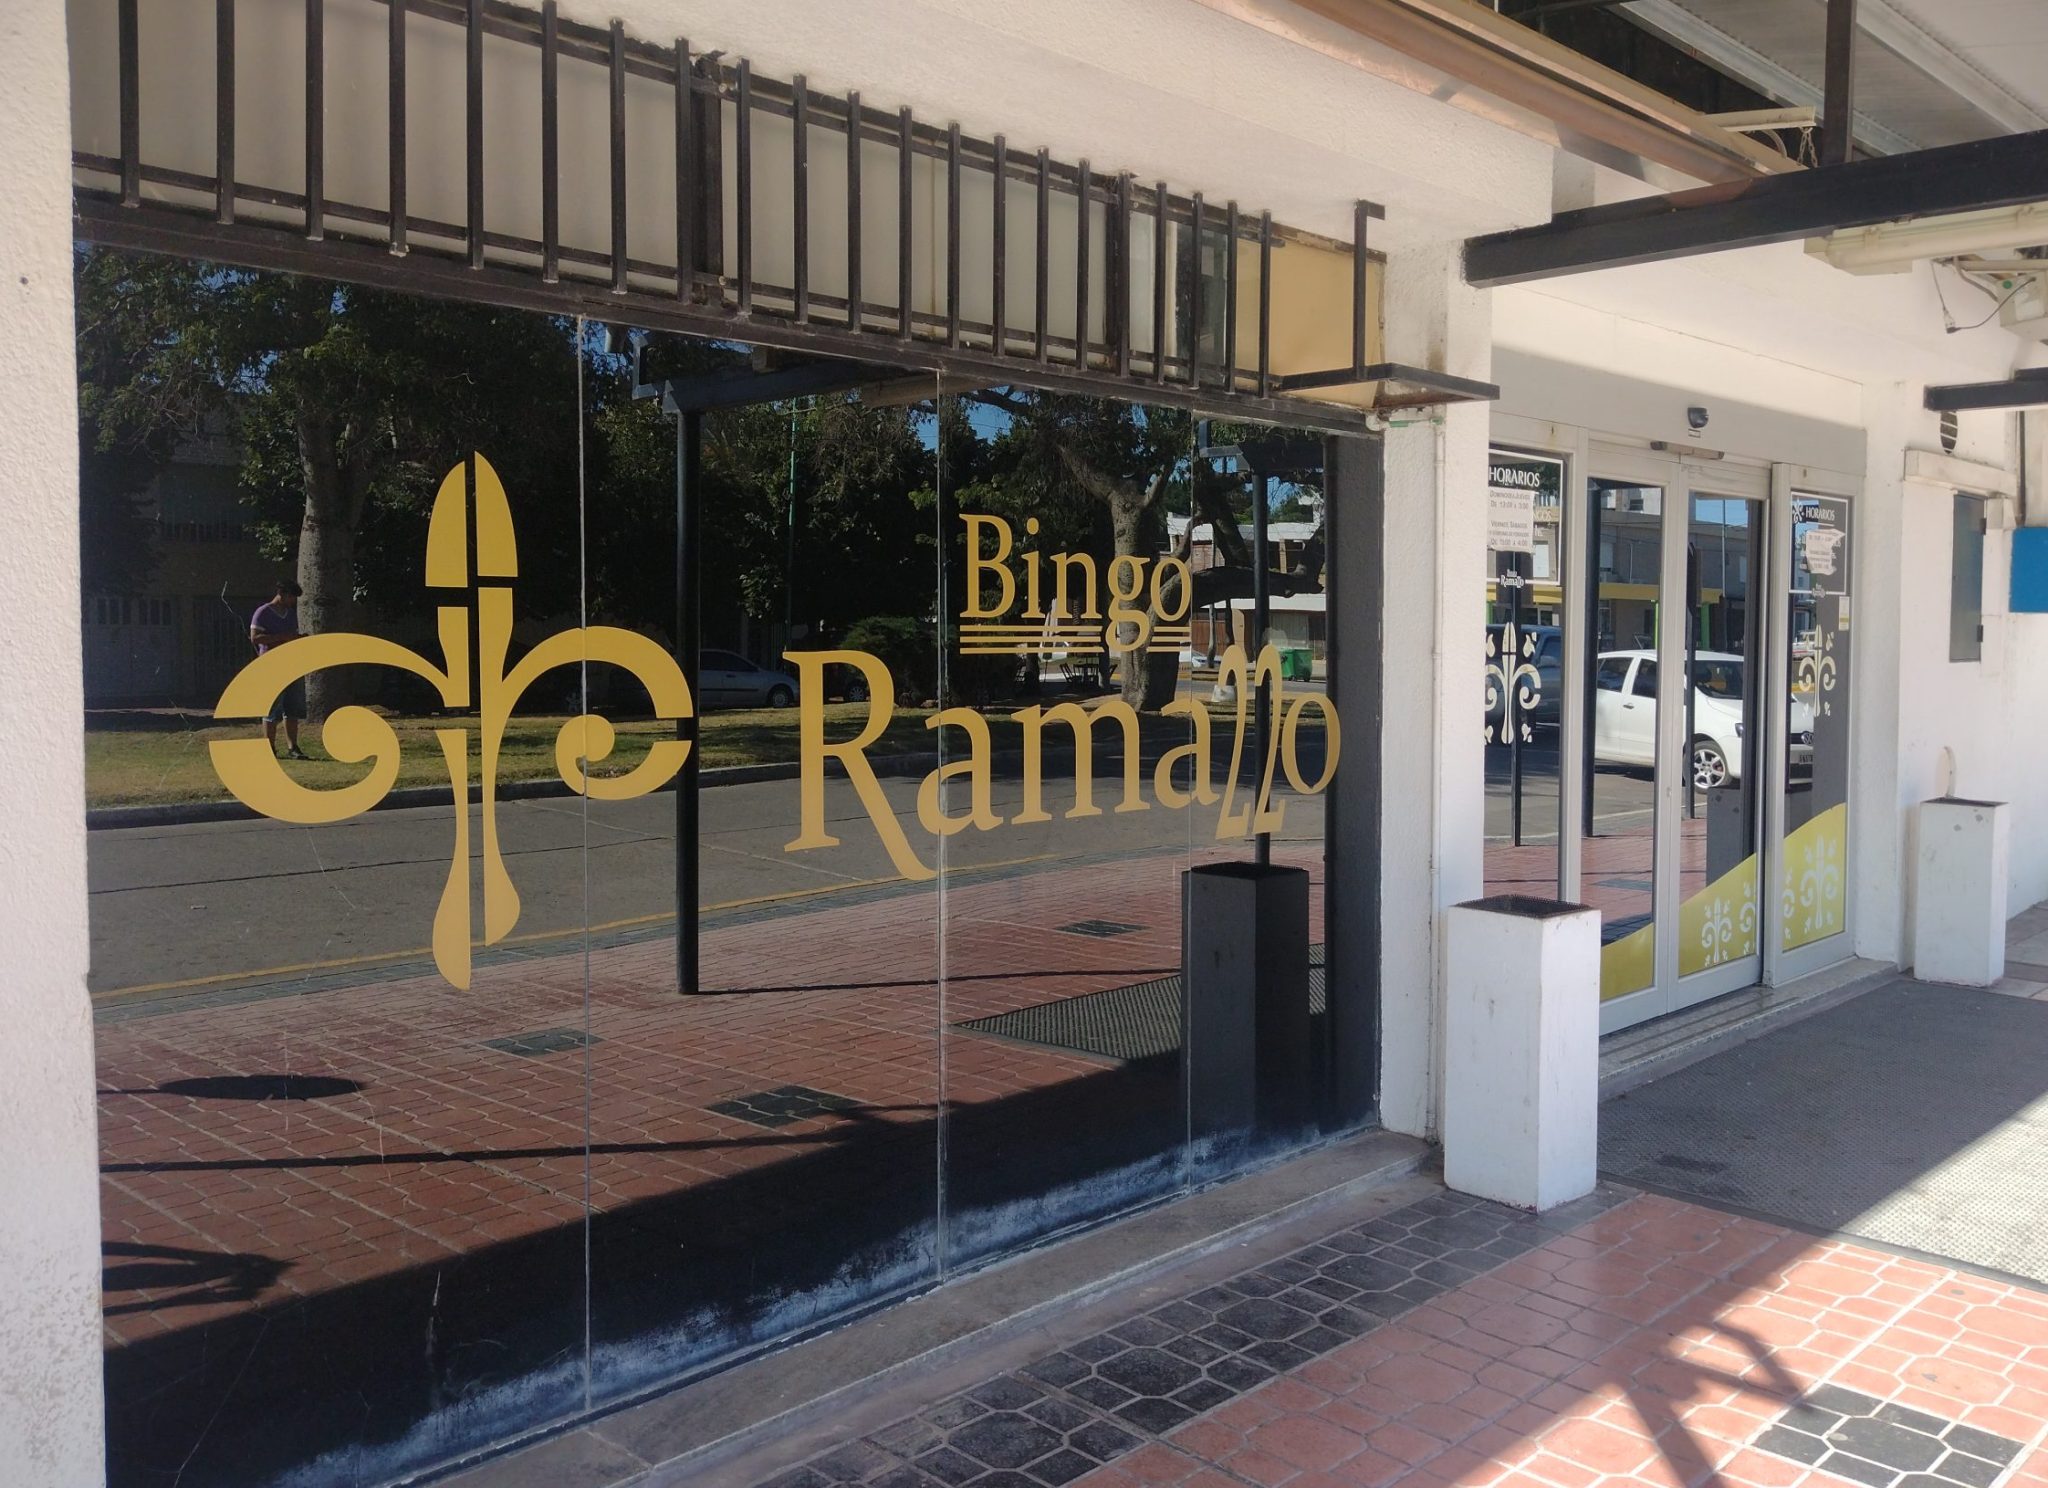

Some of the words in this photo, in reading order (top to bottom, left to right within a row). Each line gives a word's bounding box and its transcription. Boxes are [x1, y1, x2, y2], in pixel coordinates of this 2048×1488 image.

[1489, 465, 1540, 487] HORARIOS
[1805, 506, 1835, 521] HORARIOS
[958, 513, 1191, 652] Bingo
